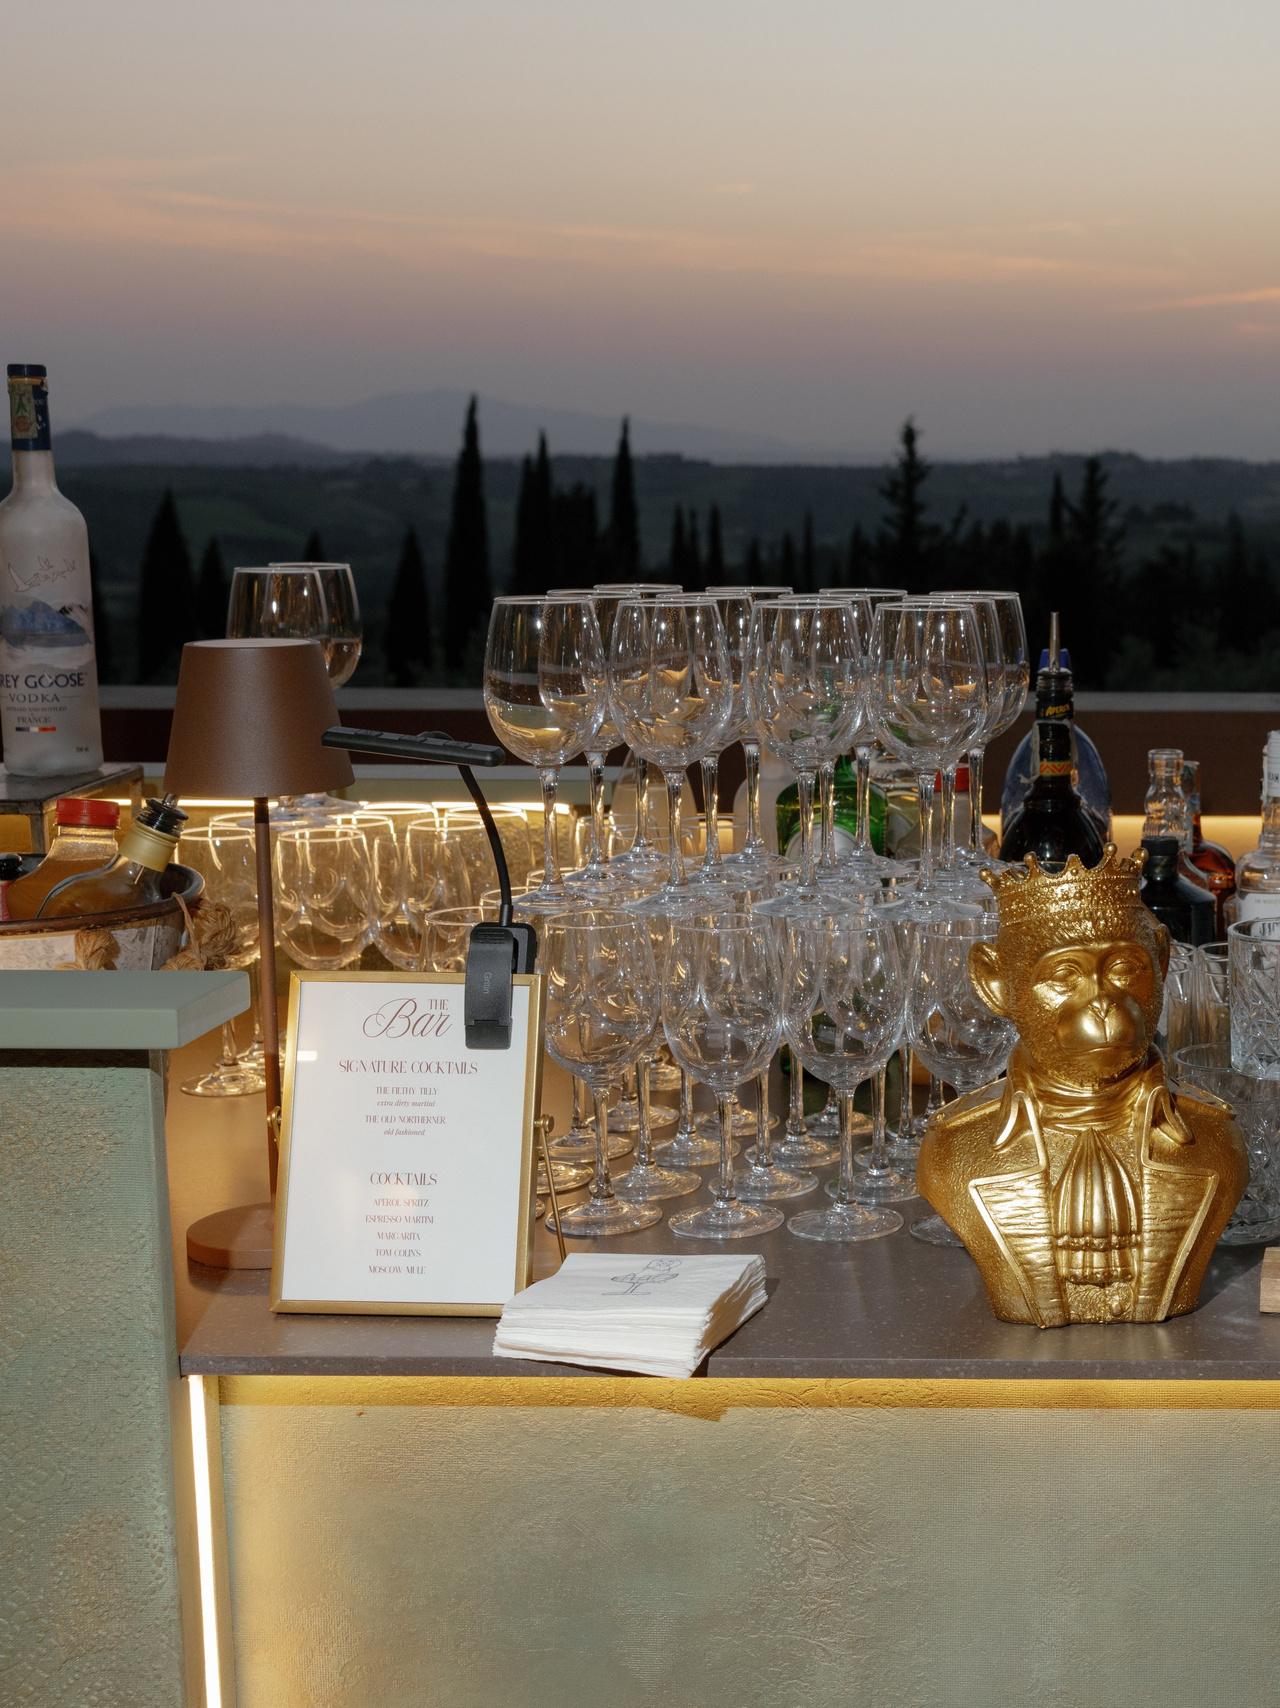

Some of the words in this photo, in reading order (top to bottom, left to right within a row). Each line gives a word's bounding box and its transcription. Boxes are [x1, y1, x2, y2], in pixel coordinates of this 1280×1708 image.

[0, 674, 19, 689] REY
[25, 672, 85, 689] GOOSE
[9, 693, 60, 703] VODKA
[17, 716, 51, 724] FRANCE
[428, 998, 449, 1010] THE
[363, 997, 453, 1039] Bar
[339, 1060, 407, 1074] SIGNATURE
[411, 1060, 478, 1075] COCKTAILS
[376, 1086, 390, 1095] THE
[391, 1086, 416, 1096] FILTHY
[419, 1087, 439, 1096] TILLY
[394, 1100, 410, 1108] dirty
[365, 1115, 379, 1124] THE
[381, 1115, 397, 1124] OLD
[399, 1116, 446, 1125] NORTHERNER
[384, 1128, 394, 1136] old
[395, 1128, 426, 1137] fashioned
[370, 1172, 438, 1186] COCKTAILS
[374, 1198, 402, 1207] APEROL
[403, 1198, 430, 1208] SPRITZ
[365, 1214, 402, 1224] ESPRESSO
[404, 1215, 435, 1225] MARTINI
[377, 1231, 421, 1241] MARGARITA
[375, 1249, 392, 1257] TOM
[368, 1265, 402, 1275] MOSCOW
[405, 1266, 427, 1275] MULE
